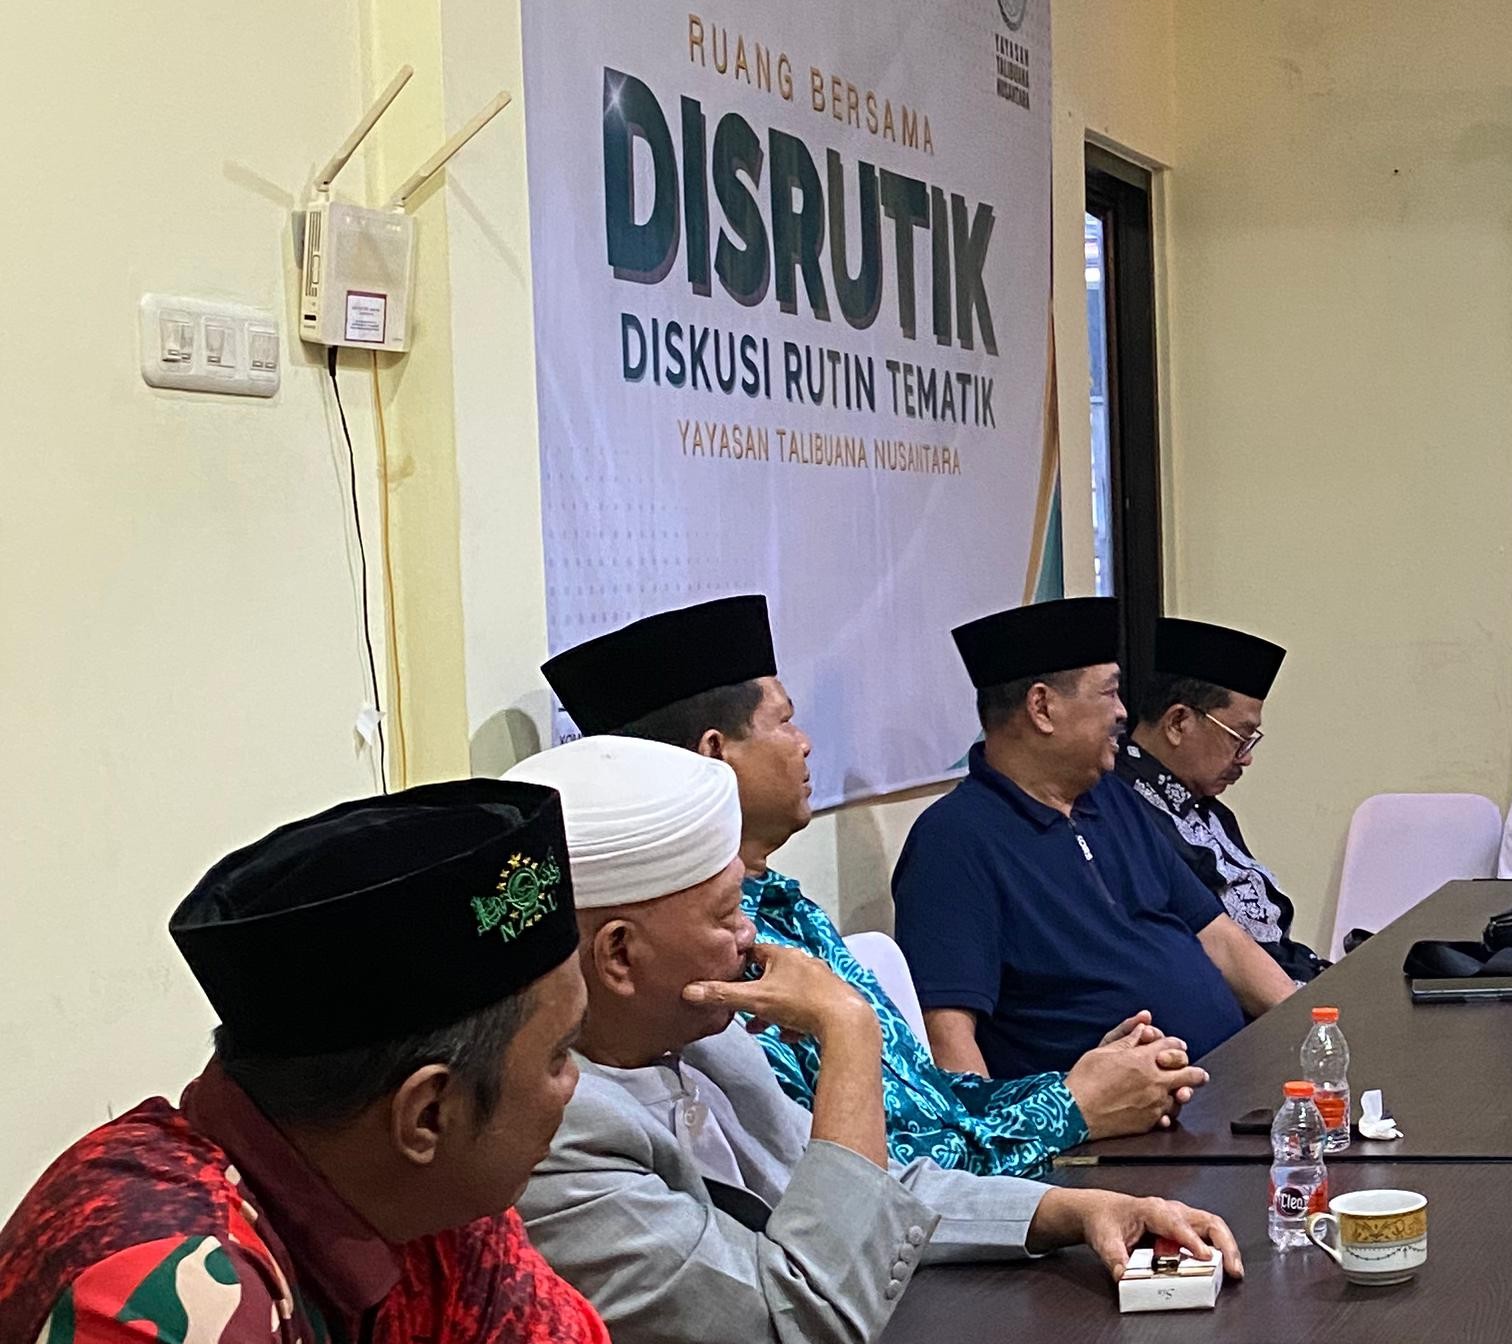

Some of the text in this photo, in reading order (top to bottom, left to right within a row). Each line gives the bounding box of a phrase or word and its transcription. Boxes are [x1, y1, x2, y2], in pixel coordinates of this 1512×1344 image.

[687, 13, 935, 155] RUANG BERSAMA
[603, 66, 999, 357] DISRUTIK
[620, 312, 997, 429] DISKUSI RUTIN TEMATIK
[676, 418, 963, 476] YAYASAN TALIBUANA NUSANTARA
